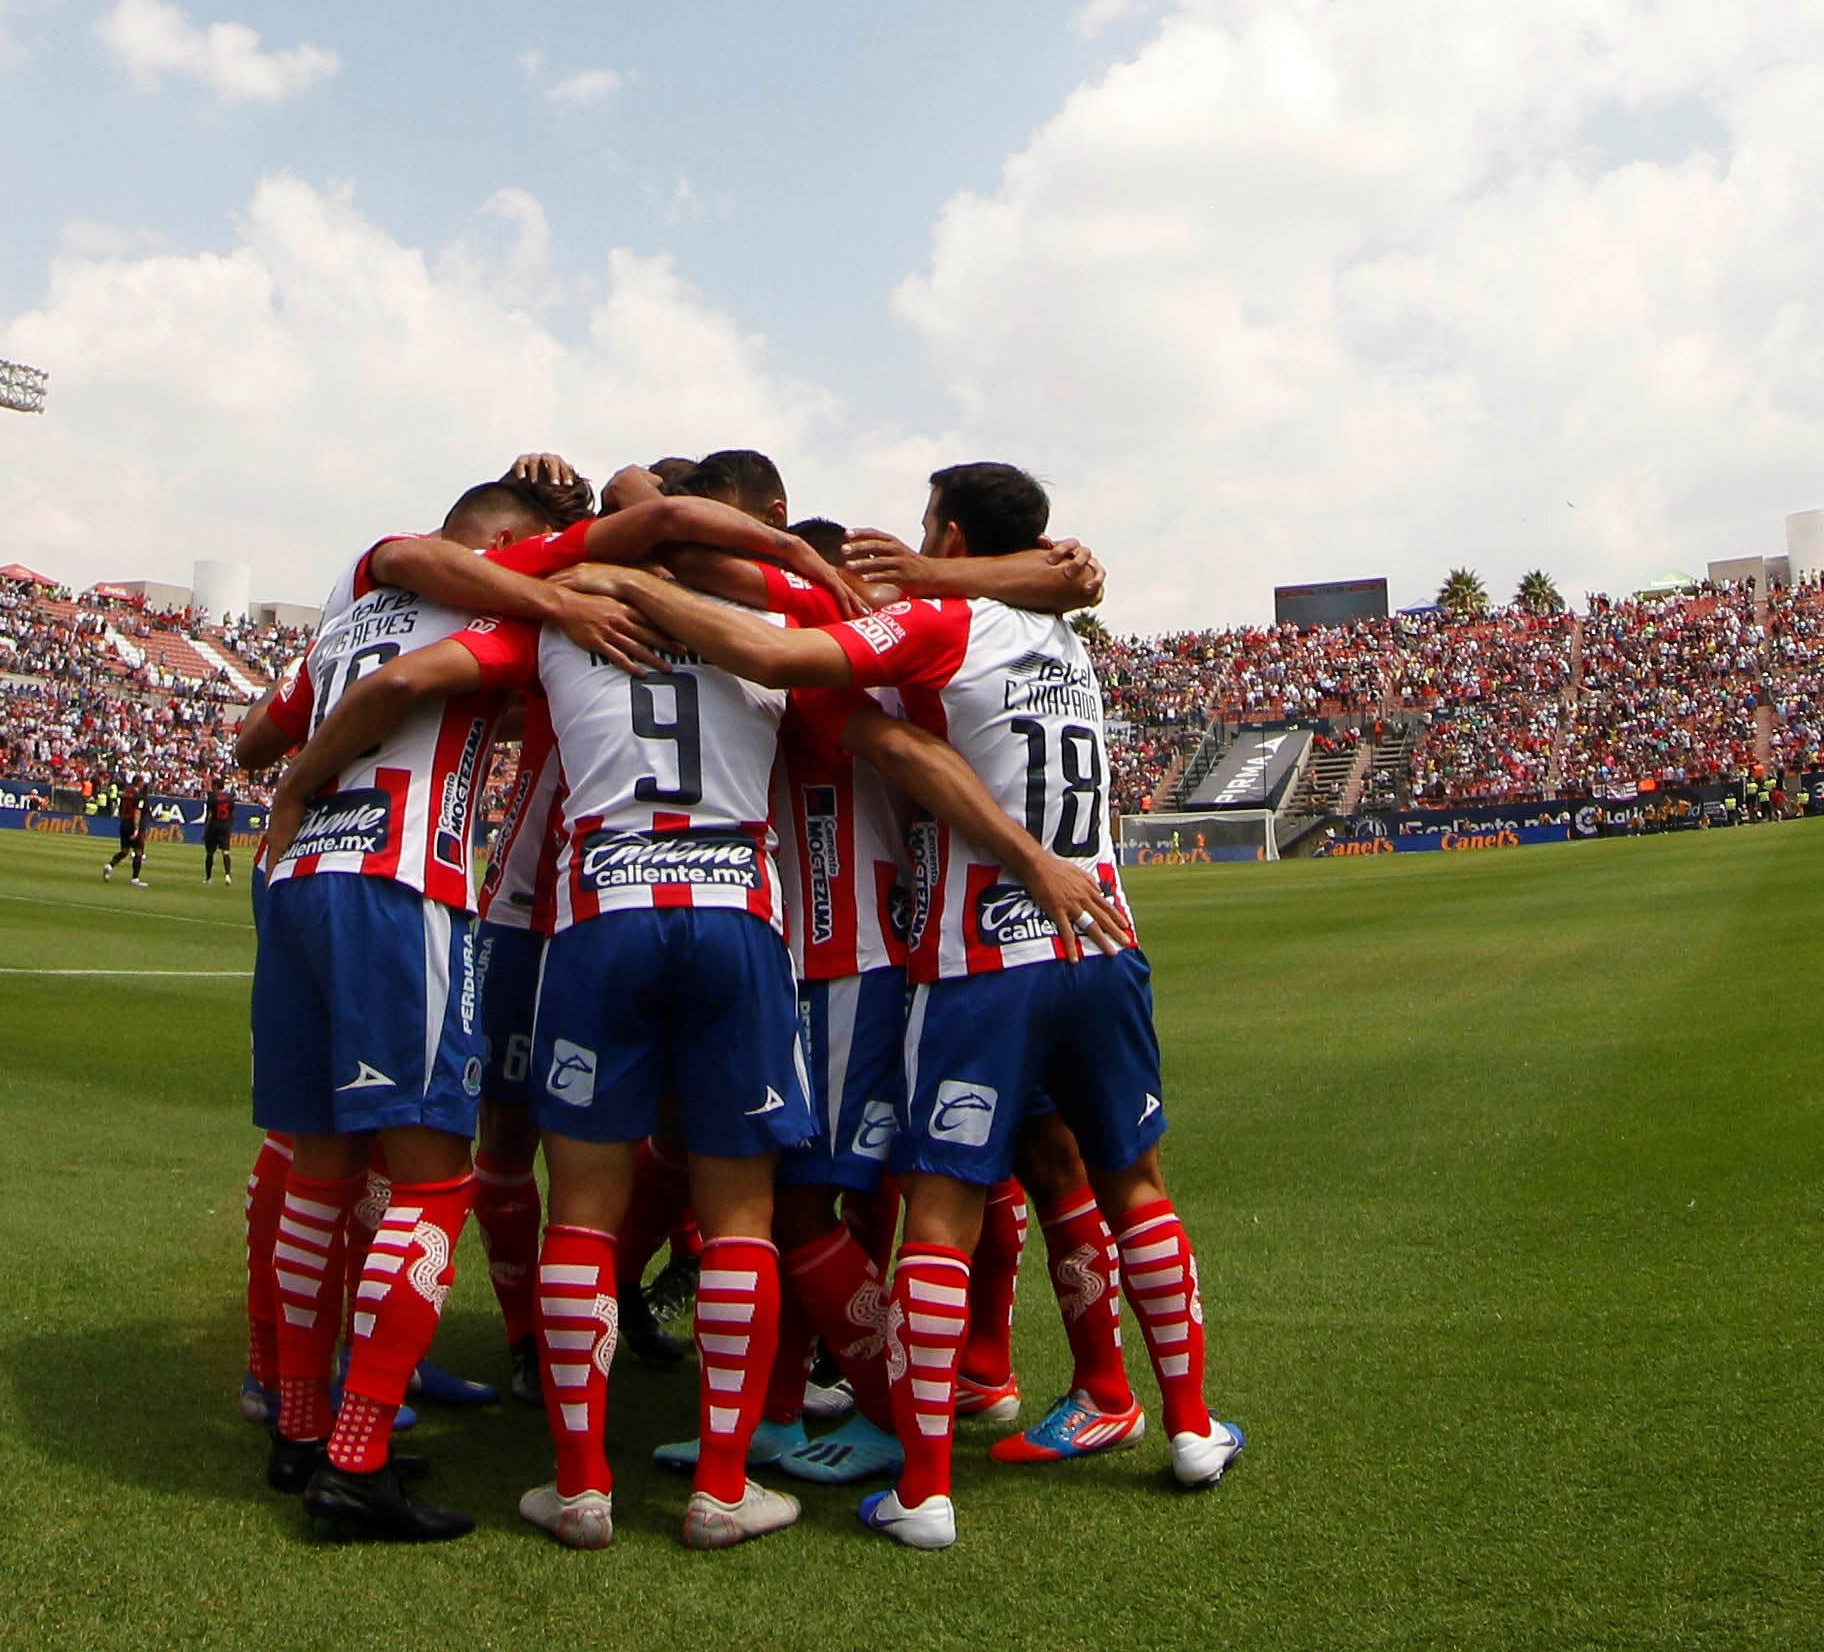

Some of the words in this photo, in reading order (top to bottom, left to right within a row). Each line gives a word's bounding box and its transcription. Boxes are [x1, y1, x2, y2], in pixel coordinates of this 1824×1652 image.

[351, 609, 419, 649] REYES
[629, 670, 703, 806] 9
[452, 719, 485, 837] MOCTEZUMA
[1010, 717, 1102, 858] 18
[1214, 753, 1266, 805] PIRMA
[25, 810, 90, 836] Canel's
[1332, 837, 1395, 857] anel's
[1440, 829, 1521, 852] Canel's
[596, 864, 755, 888] caliente.mx
[806, 819, 833, 946] MOCTEZUMA
[461, 933, 475, 1036] PERDURA
